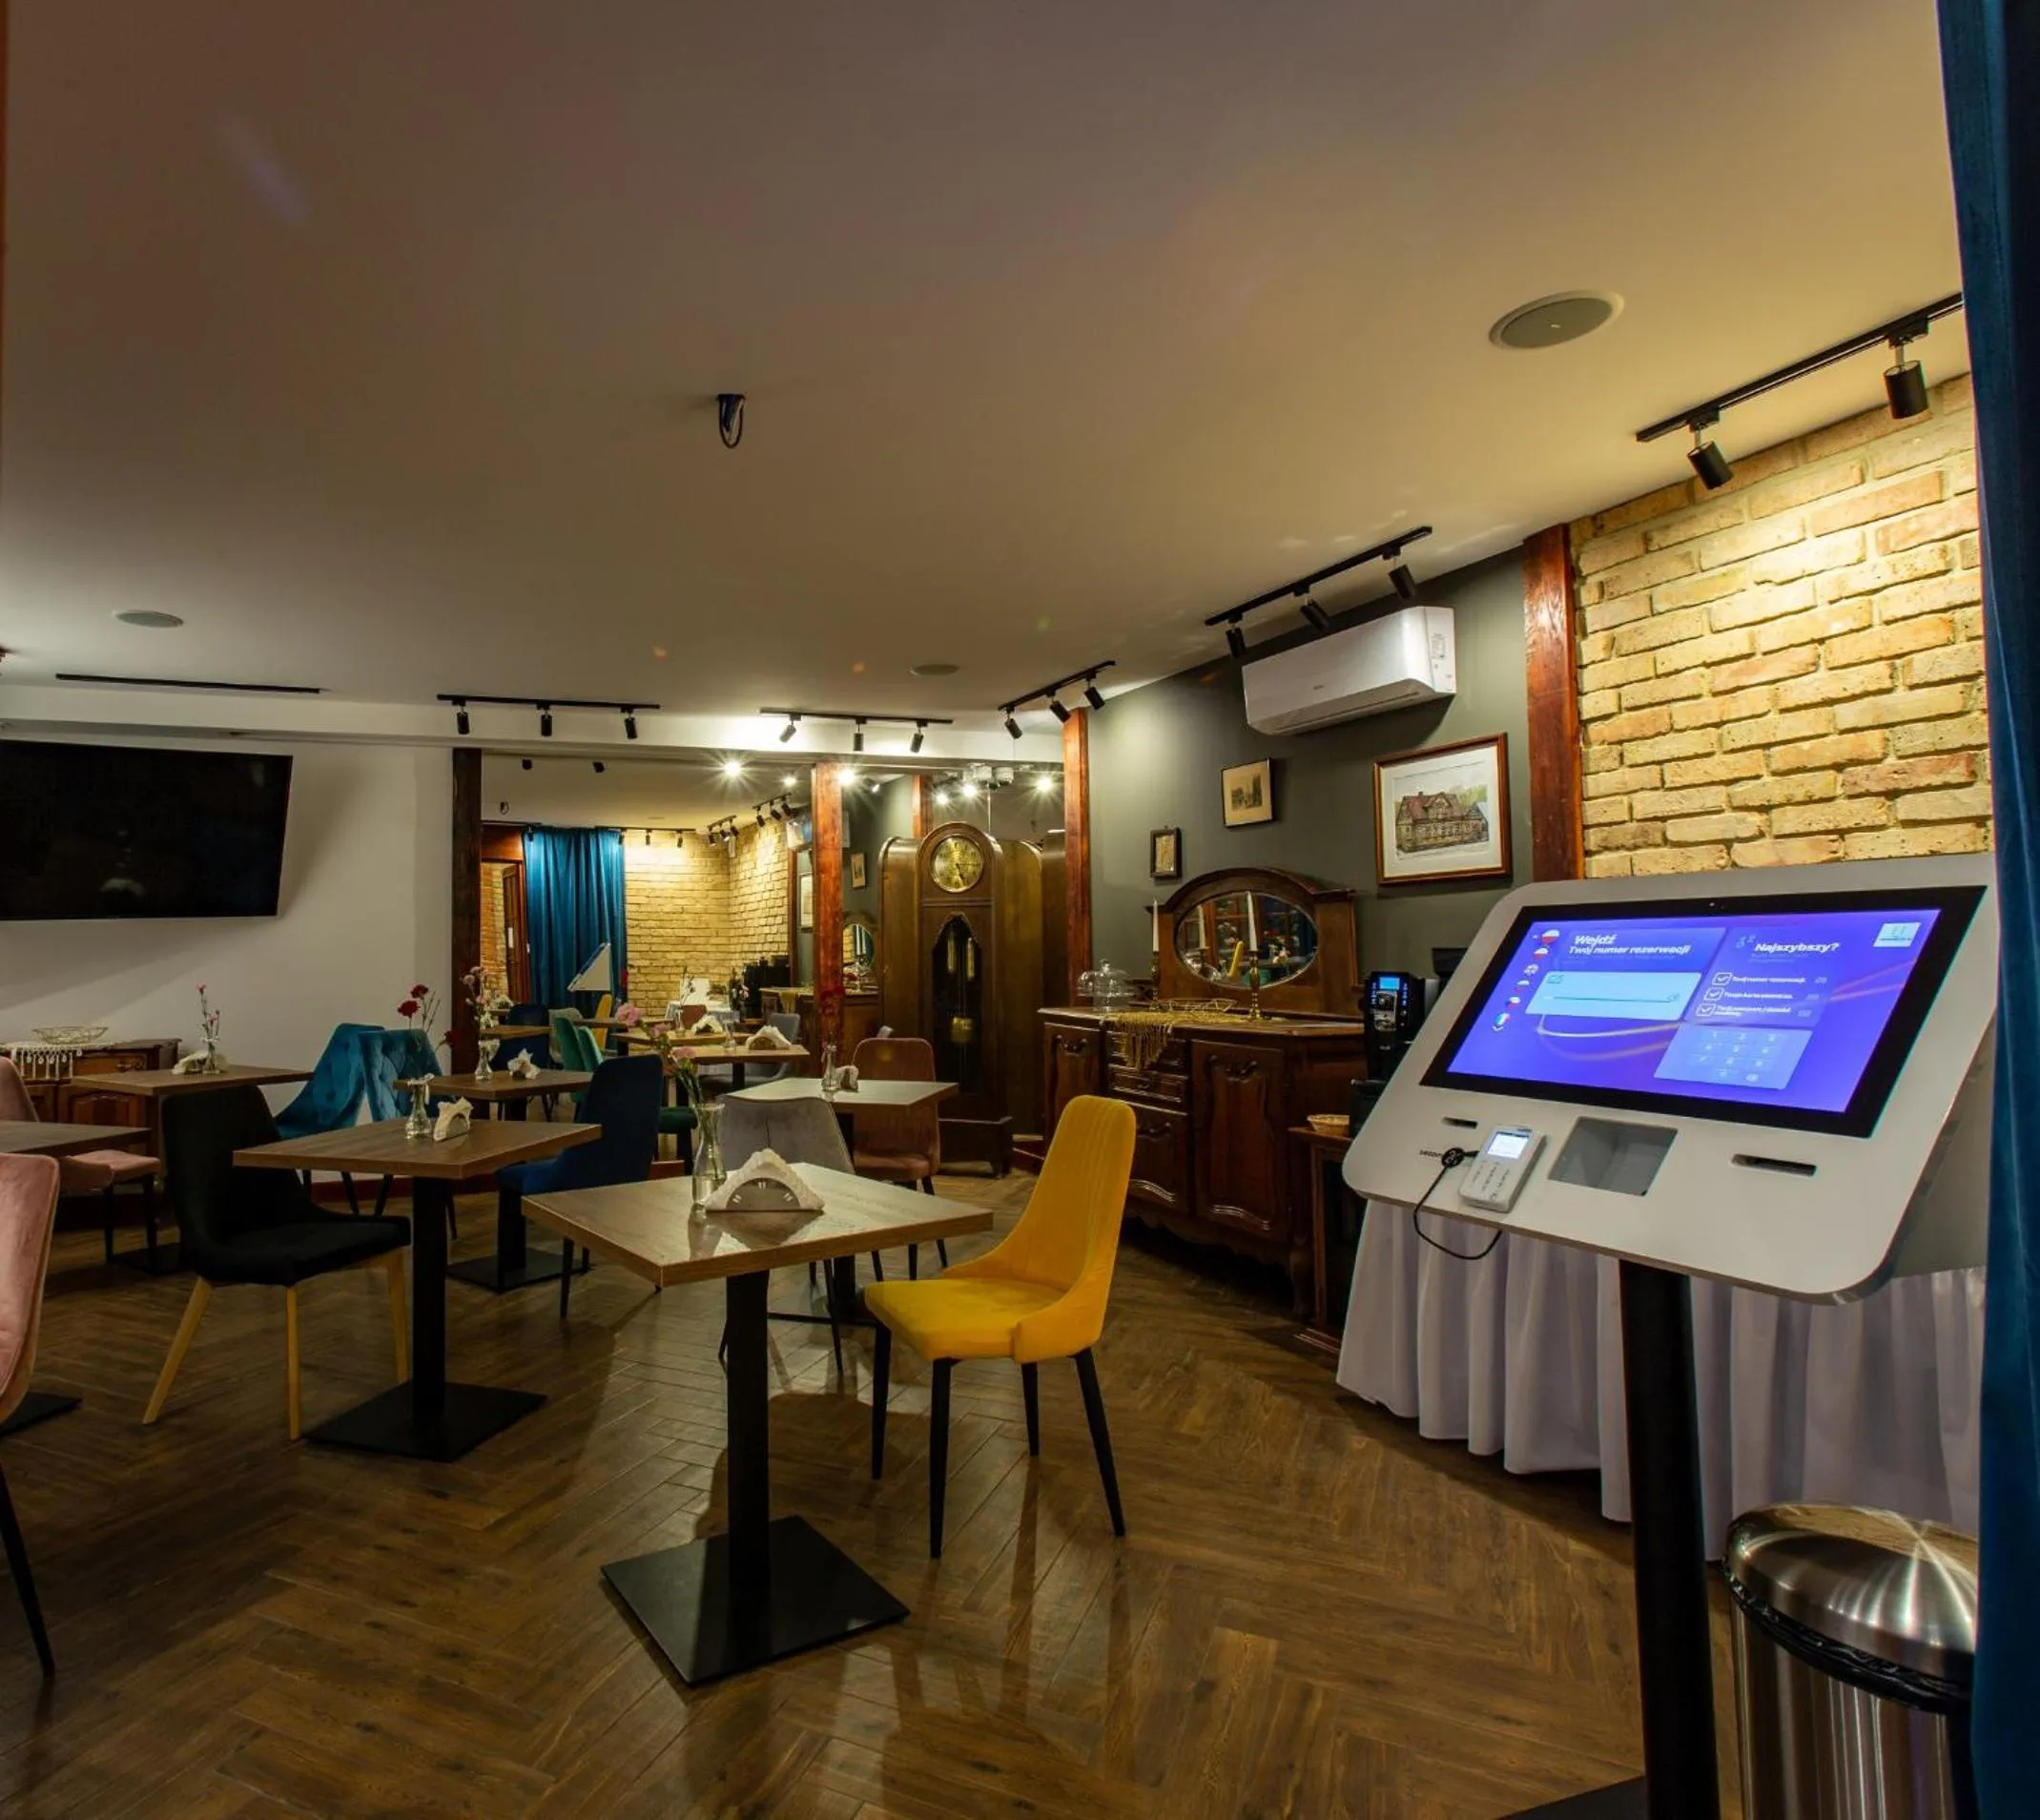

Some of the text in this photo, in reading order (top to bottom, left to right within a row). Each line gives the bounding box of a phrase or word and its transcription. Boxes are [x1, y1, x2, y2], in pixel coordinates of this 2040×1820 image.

[1575, 934, 1617, 945] Wejdź
[1569, 945, 1592, 955] Twój
[1630, 944, 1692, 955] rezerwacji
[1755, 942, 1840, 953] Najszybszy?
